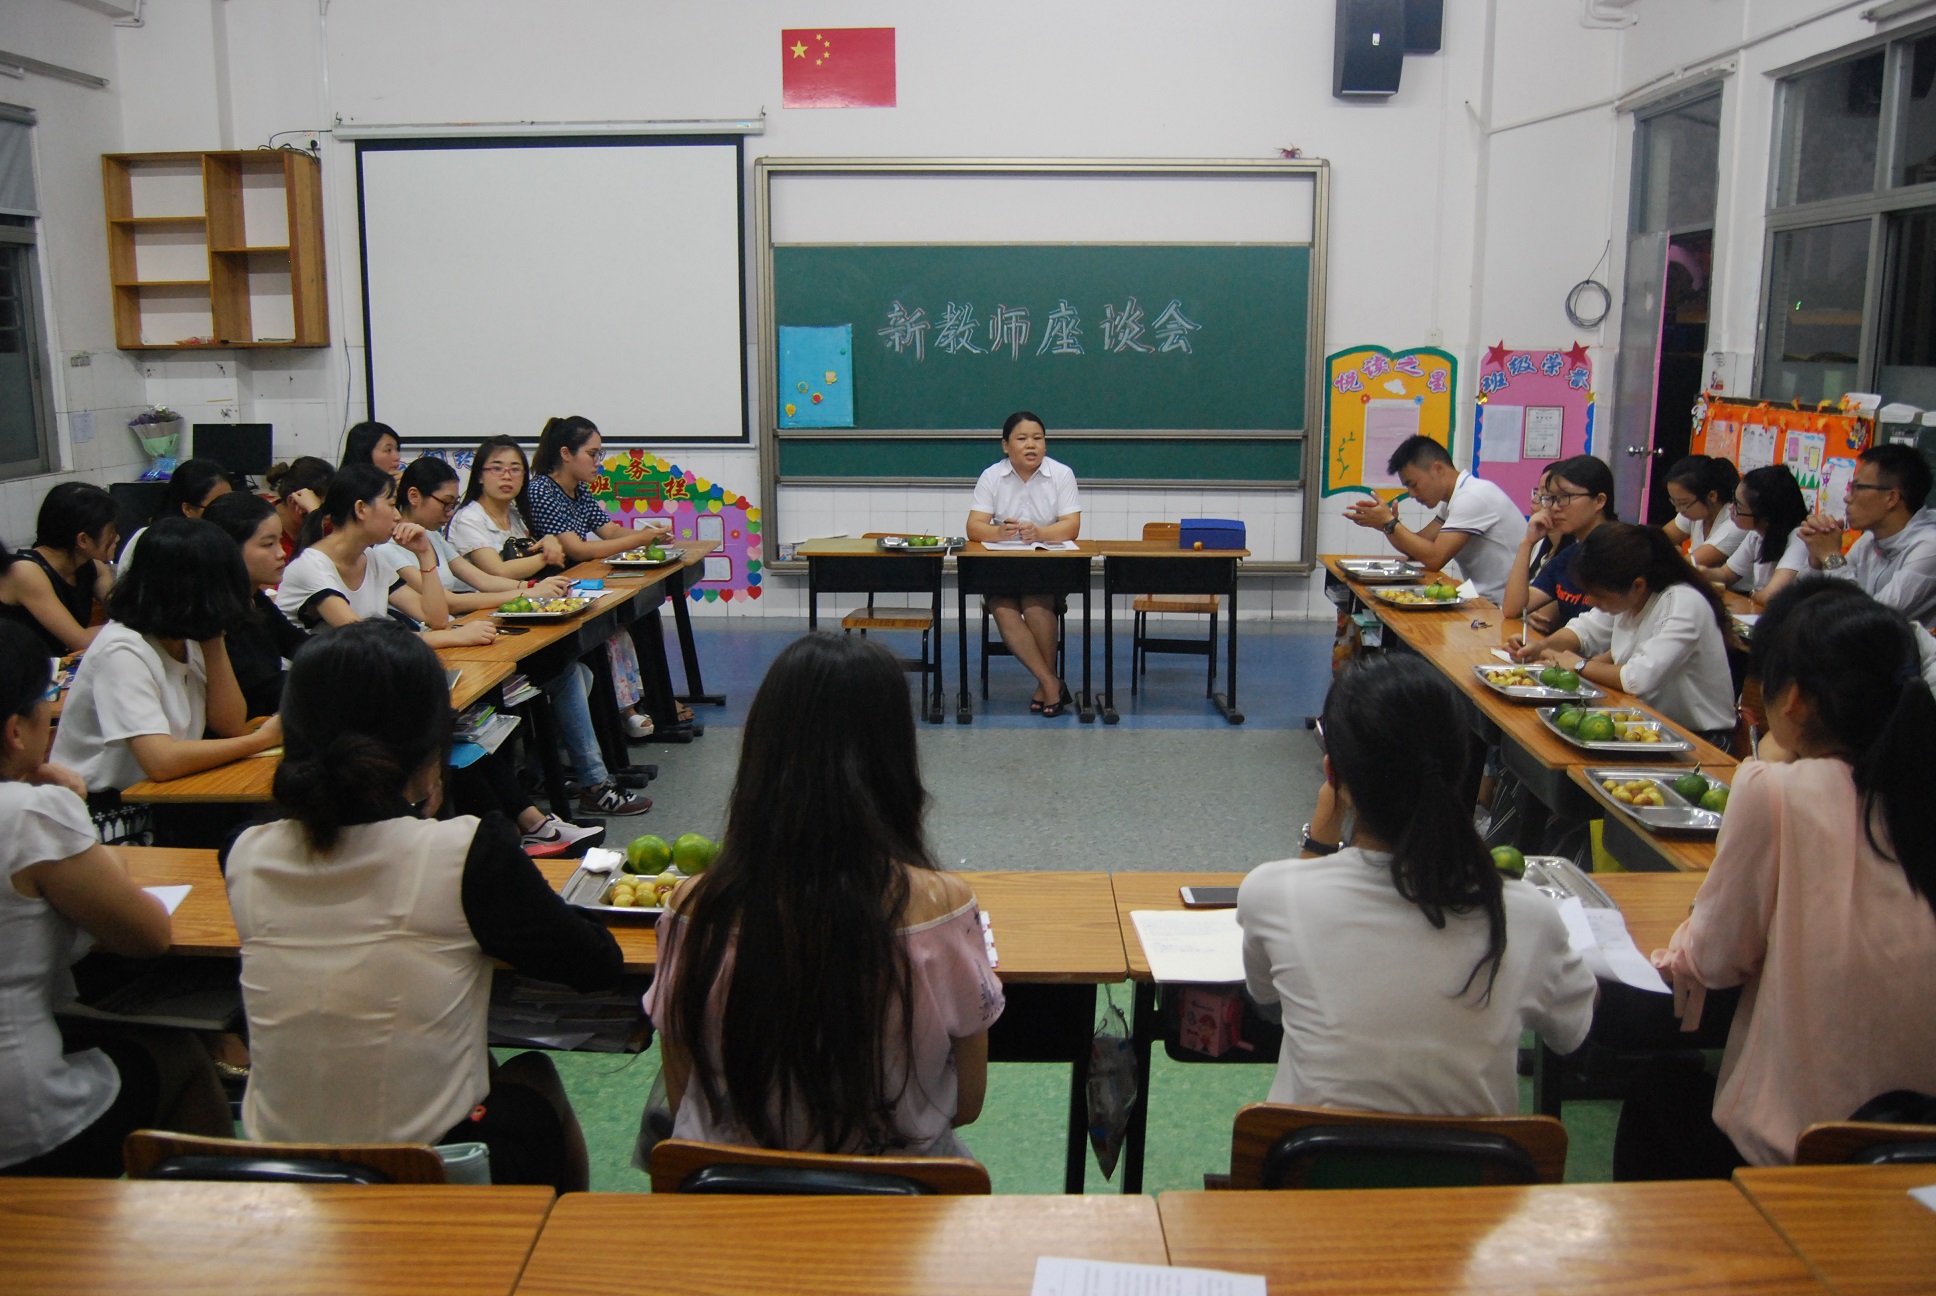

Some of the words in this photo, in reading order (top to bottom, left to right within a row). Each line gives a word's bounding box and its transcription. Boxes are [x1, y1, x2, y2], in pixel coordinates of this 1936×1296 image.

[878, 296, 1203, 363] 新教师座谈会
[1333, 352, 1449, 393] 悦读之星
[588, 458, 690, 499] 班务栏
